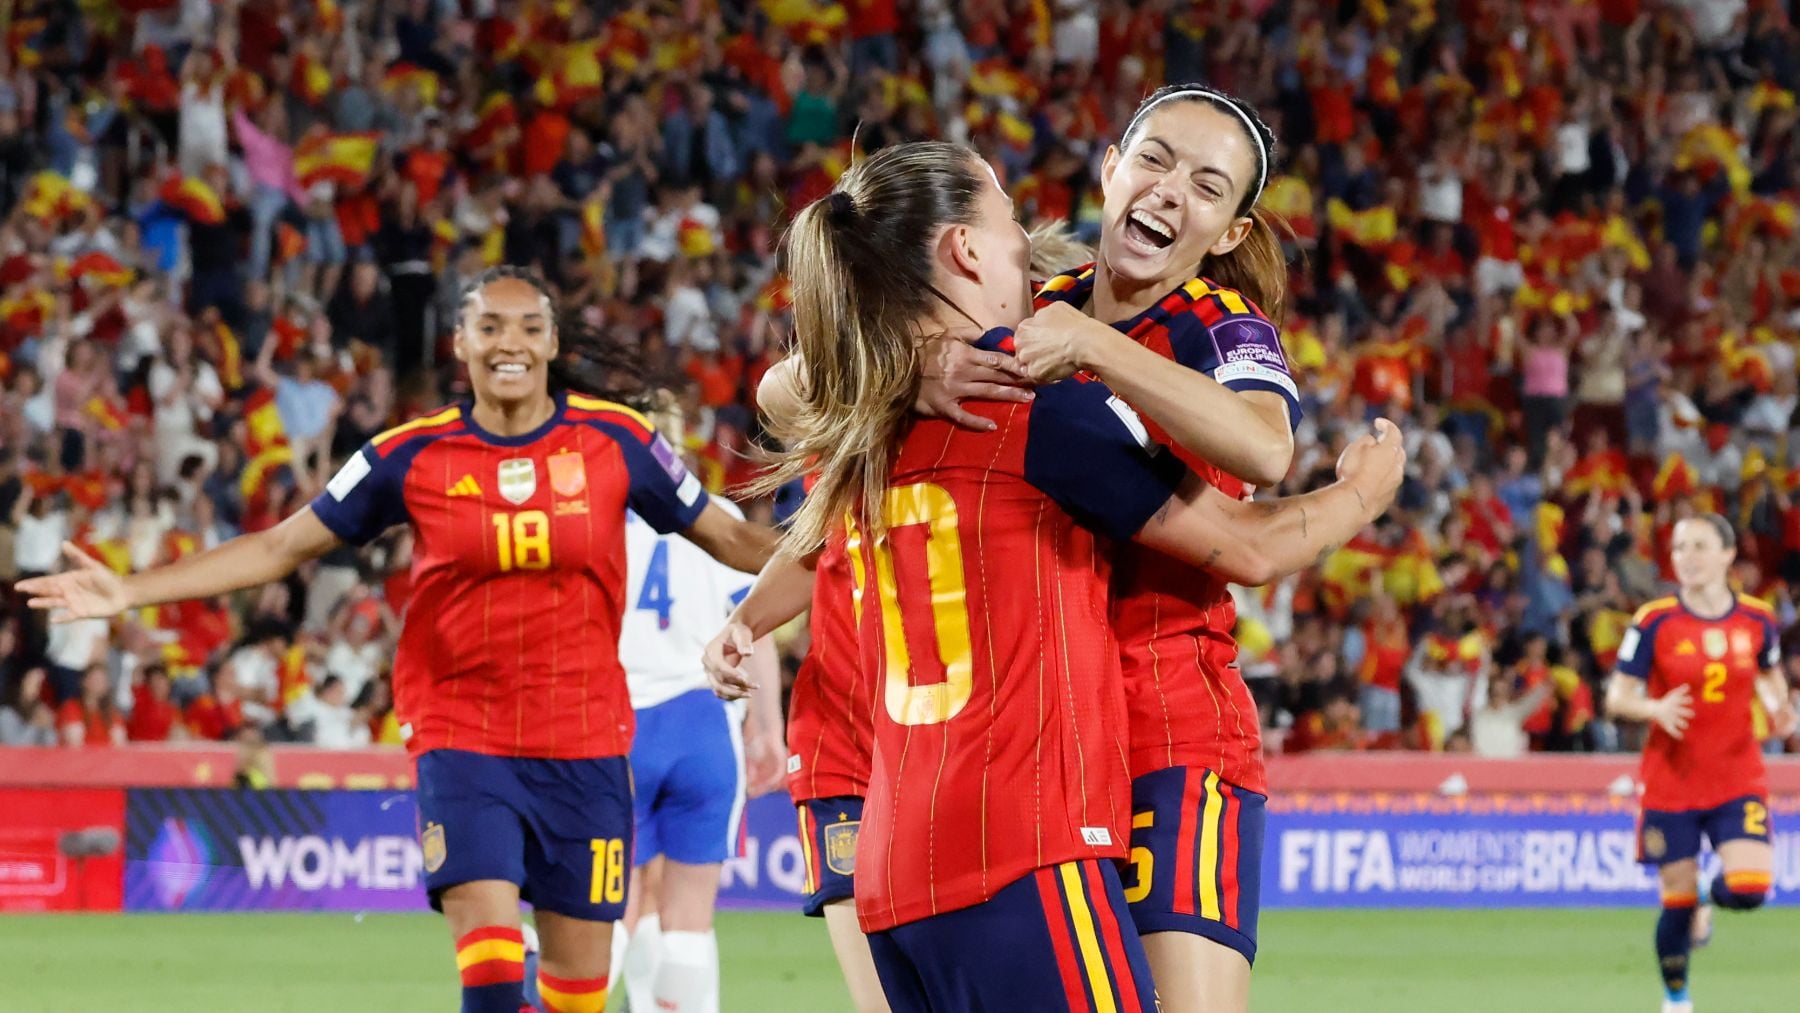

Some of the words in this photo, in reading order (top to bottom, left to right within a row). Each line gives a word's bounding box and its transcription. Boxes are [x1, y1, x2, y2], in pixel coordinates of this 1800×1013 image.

[1226, 347, 1280, 359] EUROPEAN
[492, 510, 551, 572] 18
[637, 540, 674, 631] 4
[1703, 663, 1727, 703] 2
[1743, 801, 1767, 836] 2
[590, 838, 625, 904] 18
[1280, 830, 1397, 892] FIFA
